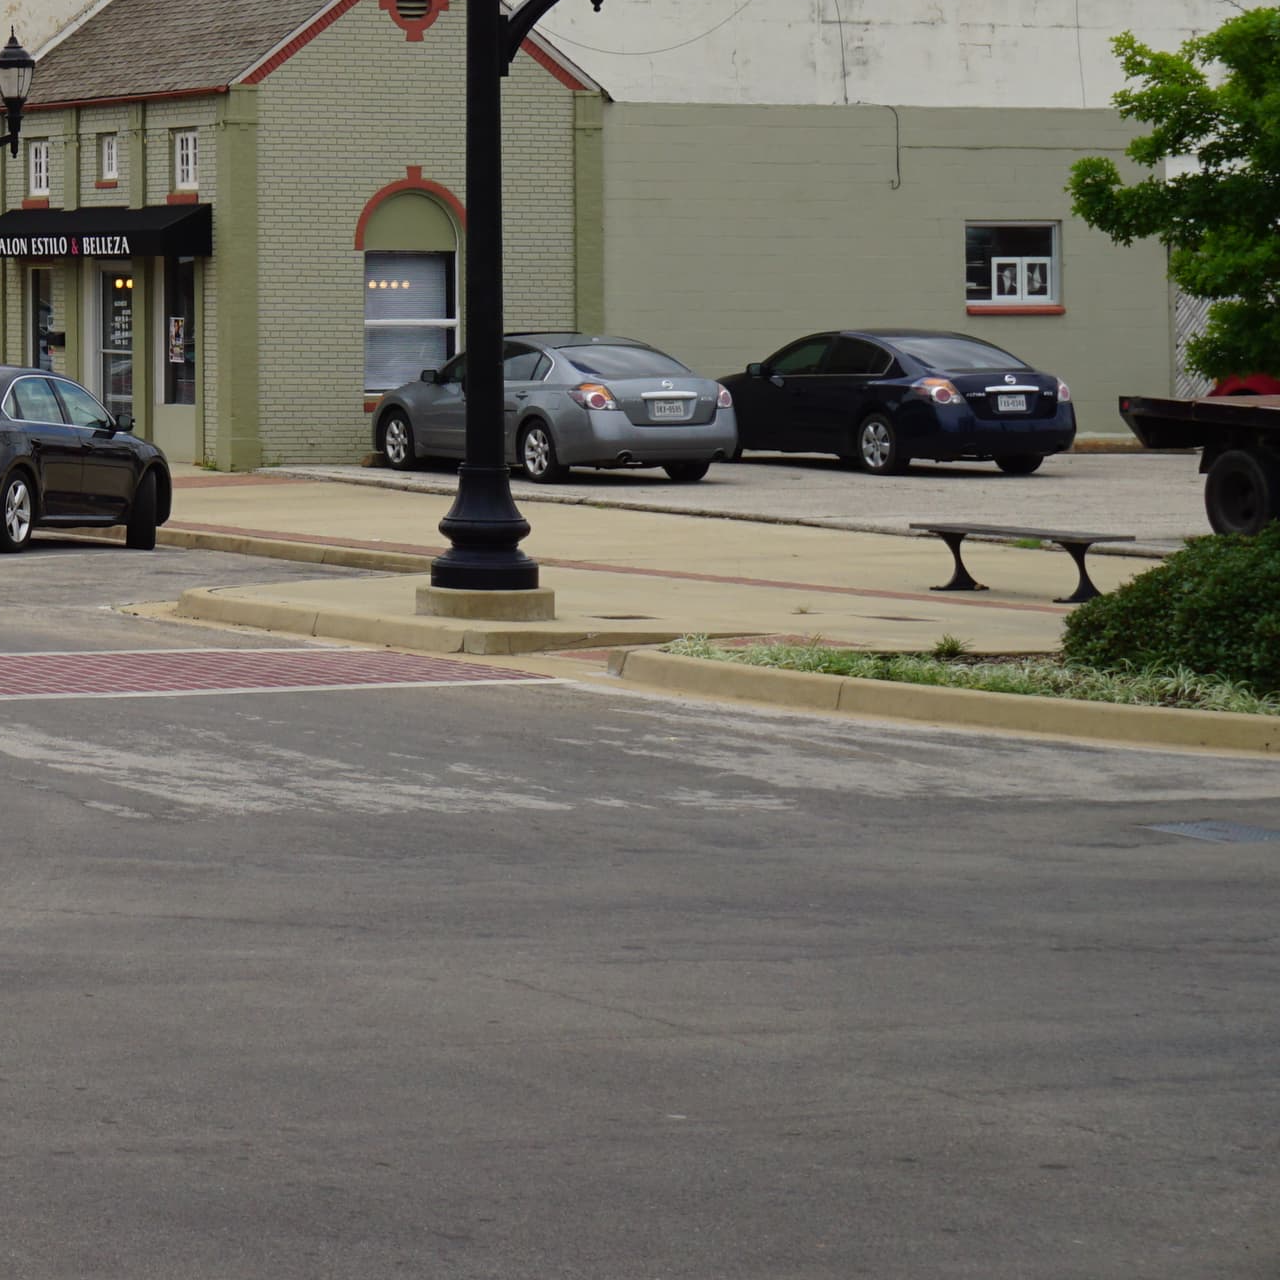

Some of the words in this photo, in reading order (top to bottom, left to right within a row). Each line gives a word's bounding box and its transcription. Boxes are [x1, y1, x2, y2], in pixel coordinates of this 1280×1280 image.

[31, 236, 68, 255] ESTILO
[71, 237, 79, 255] &
[82, 236, 130, 255] BELLEZA
